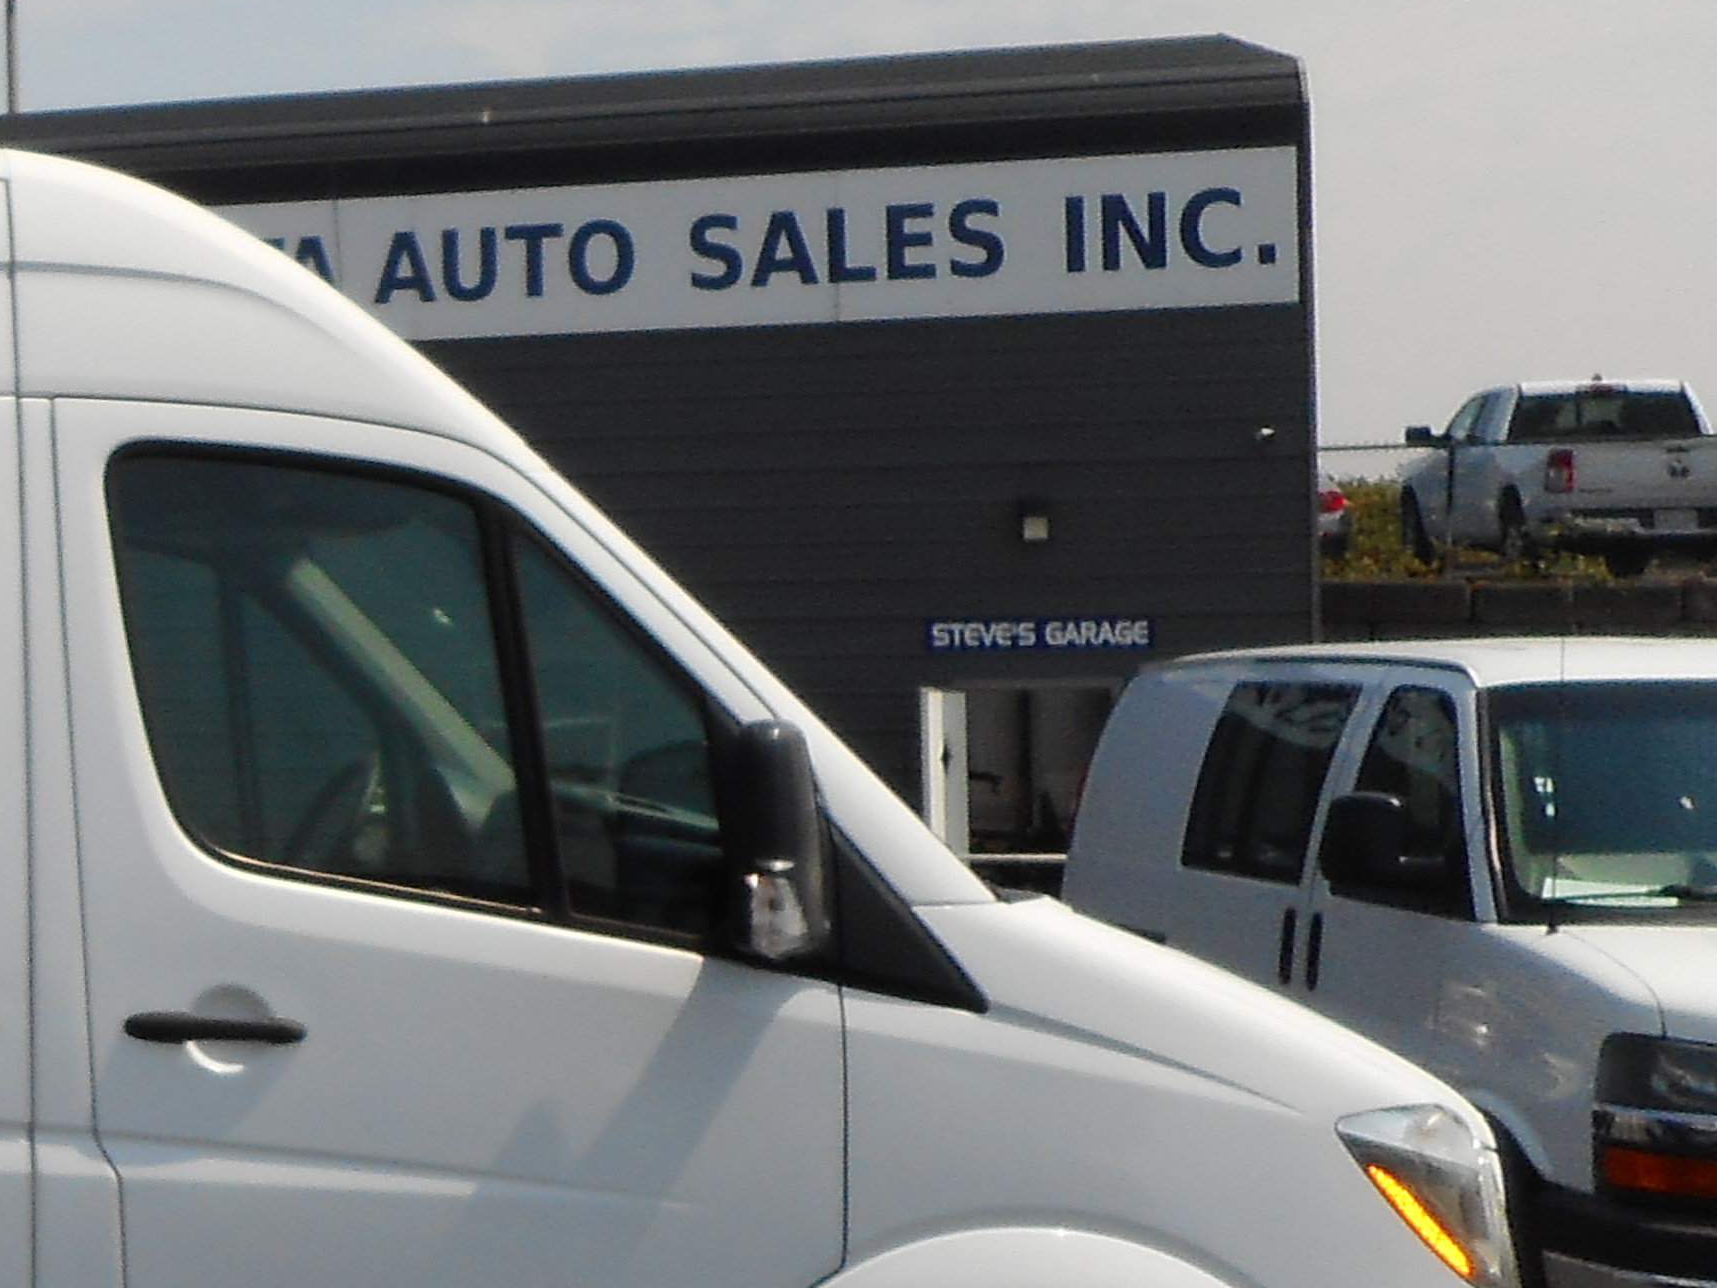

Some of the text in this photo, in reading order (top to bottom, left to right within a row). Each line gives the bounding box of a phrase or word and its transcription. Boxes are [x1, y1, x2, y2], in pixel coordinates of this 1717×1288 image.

[374, 217, 636, 304] AUTO
[689, 196, 1006, 291] SALES
[1065, 186, 1277, 274] INC.
[931, 620, 1150, 647] STEVE'S GARAGE
